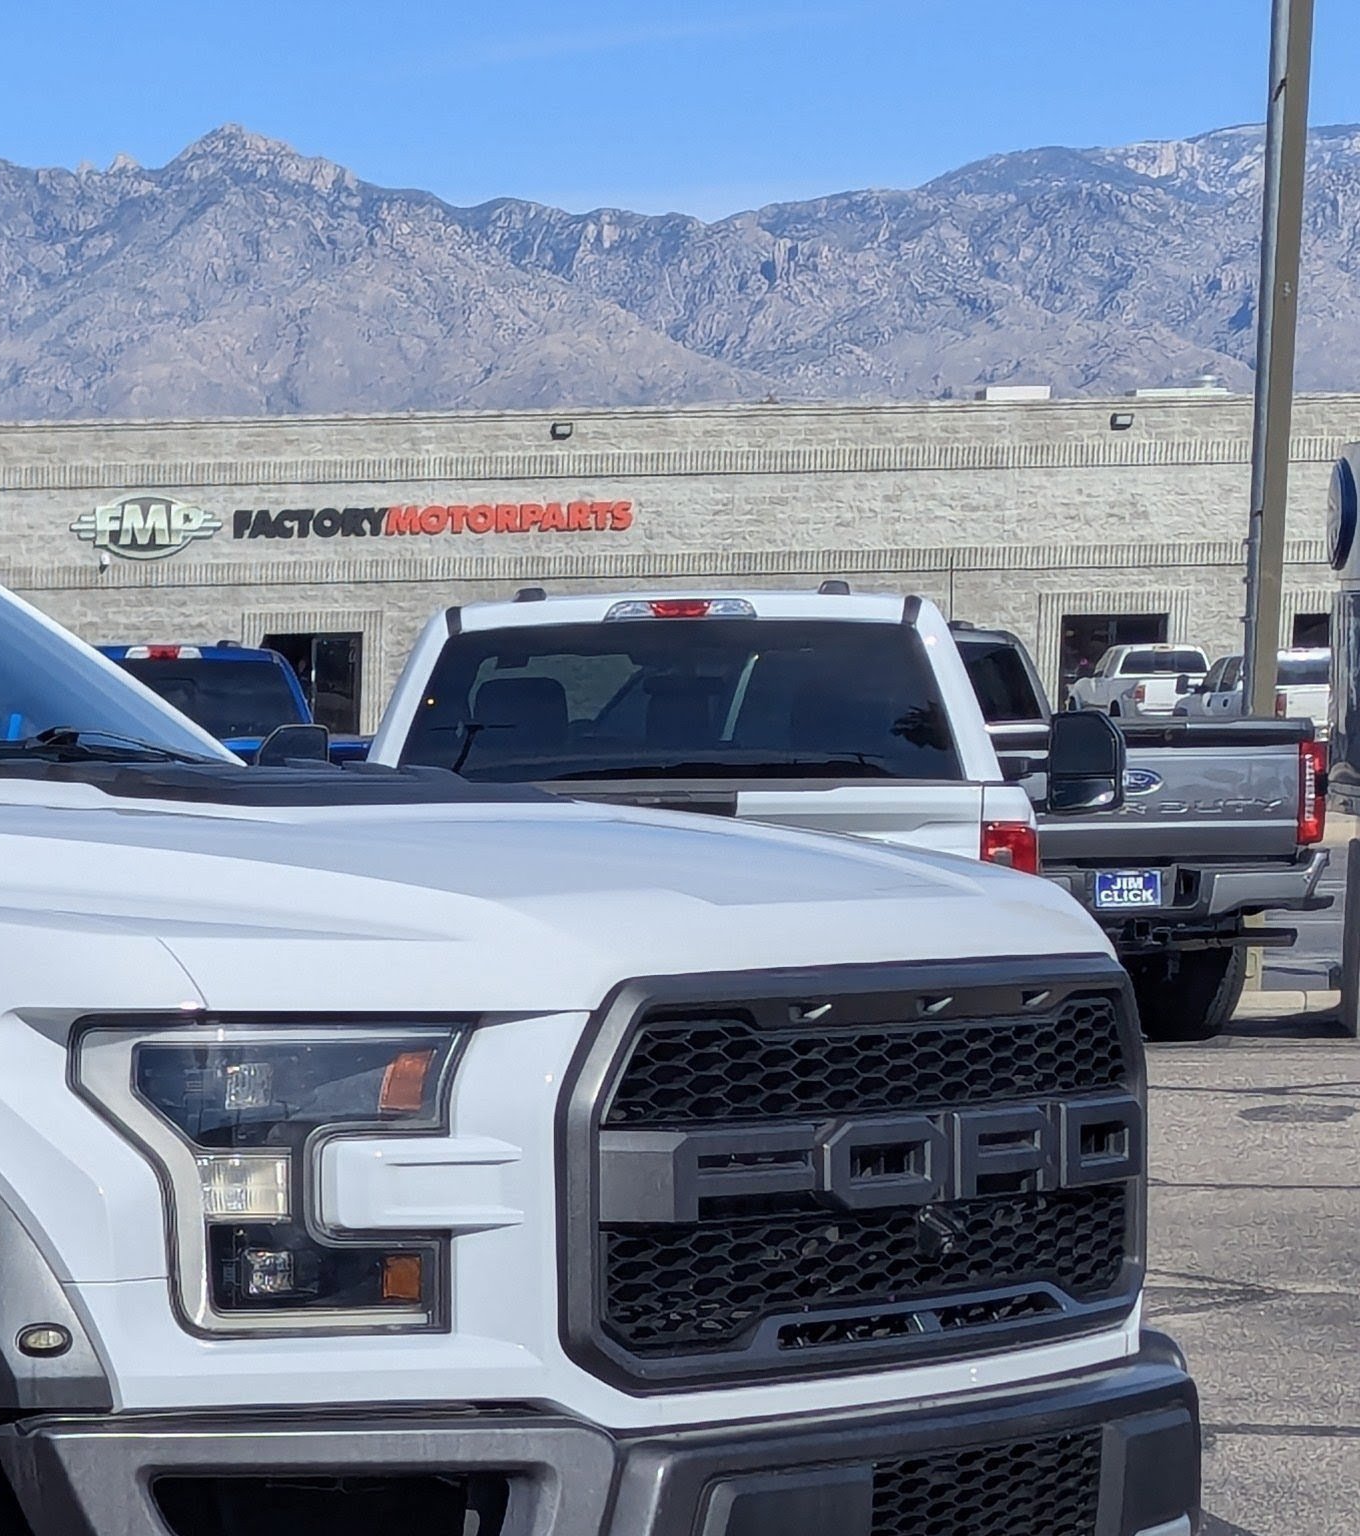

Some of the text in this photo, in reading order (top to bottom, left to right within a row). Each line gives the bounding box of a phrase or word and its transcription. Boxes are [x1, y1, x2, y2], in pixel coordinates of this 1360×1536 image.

[93, 504, 204, 547] FMP
[1100, 889, 1154, 902] CLICK
[1111, 877, 1143, 890] JIM
[673, 1099, 1142, 1222] FORD
